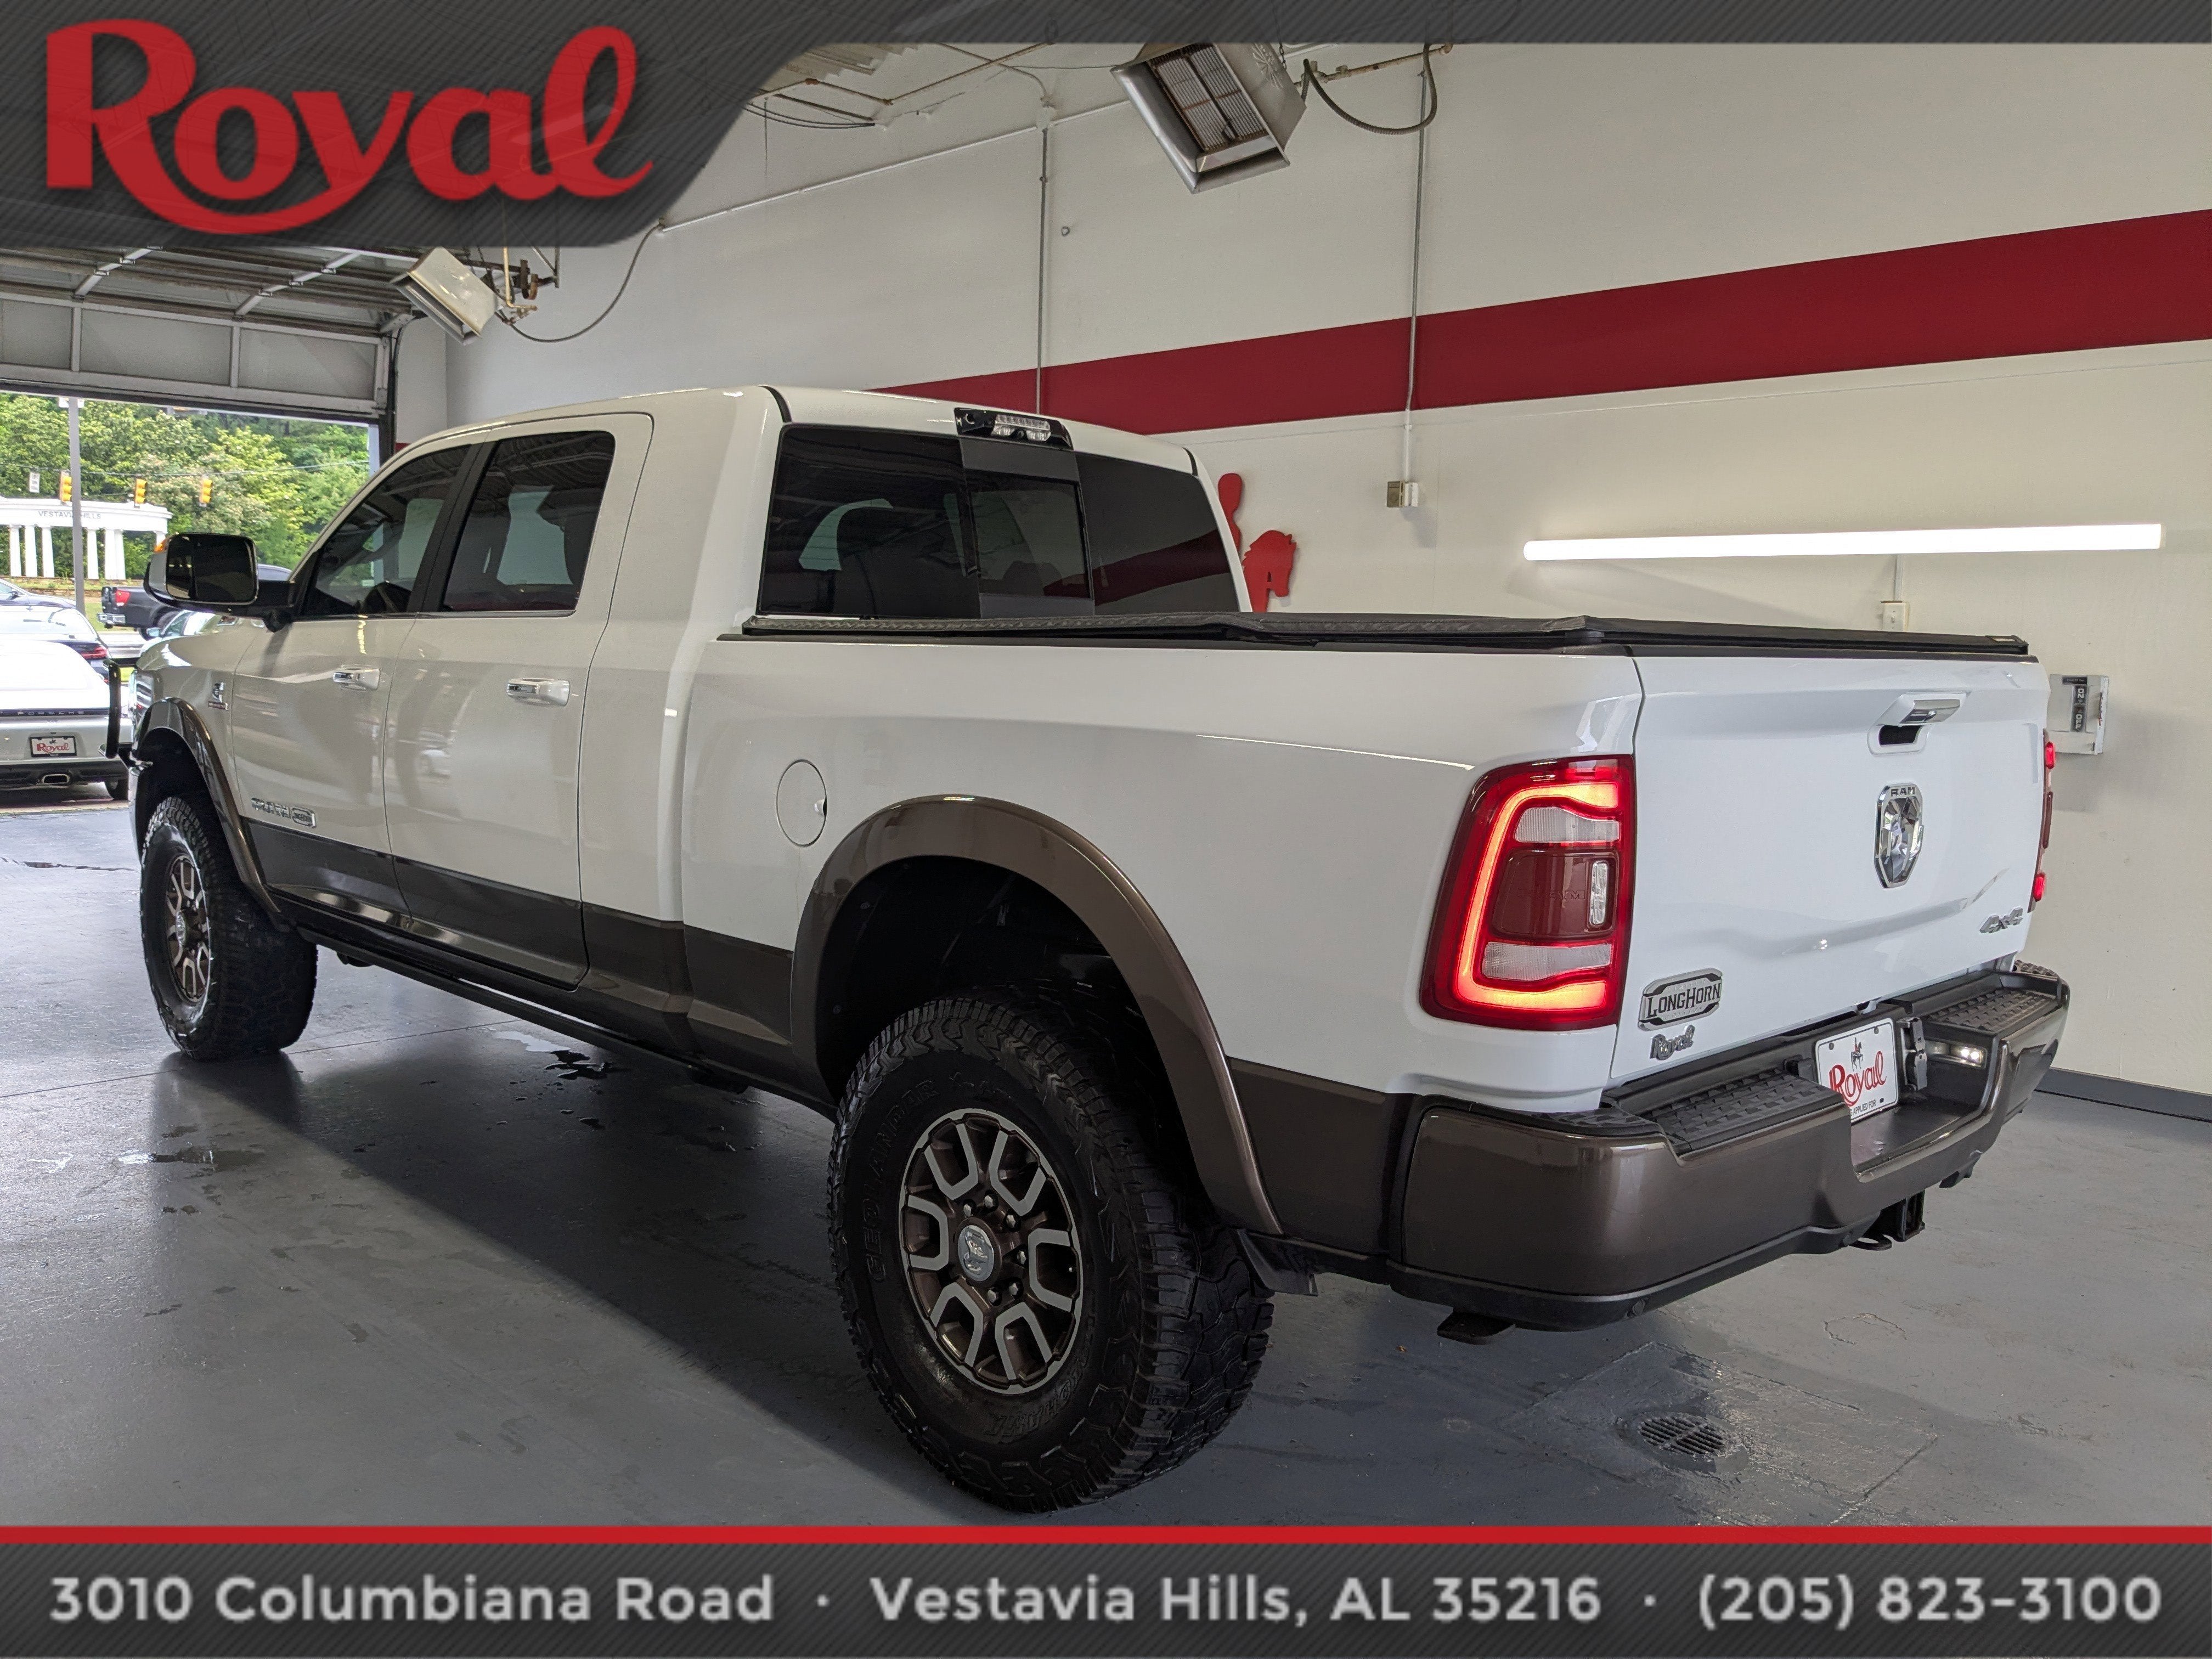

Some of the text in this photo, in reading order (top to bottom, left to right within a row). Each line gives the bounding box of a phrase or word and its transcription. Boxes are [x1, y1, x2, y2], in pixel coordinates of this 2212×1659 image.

[2077, 688, 2085, 698] ON
[36, 742, 70, 753] Royal
[1891, 786, 1916, 797] RAM
[1646, 982, 1722, 1019] LONGHORN
[1649, 1024, 1695, 1060] Royal
[1829, 1051, 1887, 1107] Royal
[1853, 1102, 1869, 1115] APPLIED
[1868, 1099, 1876, 1109] FOR
